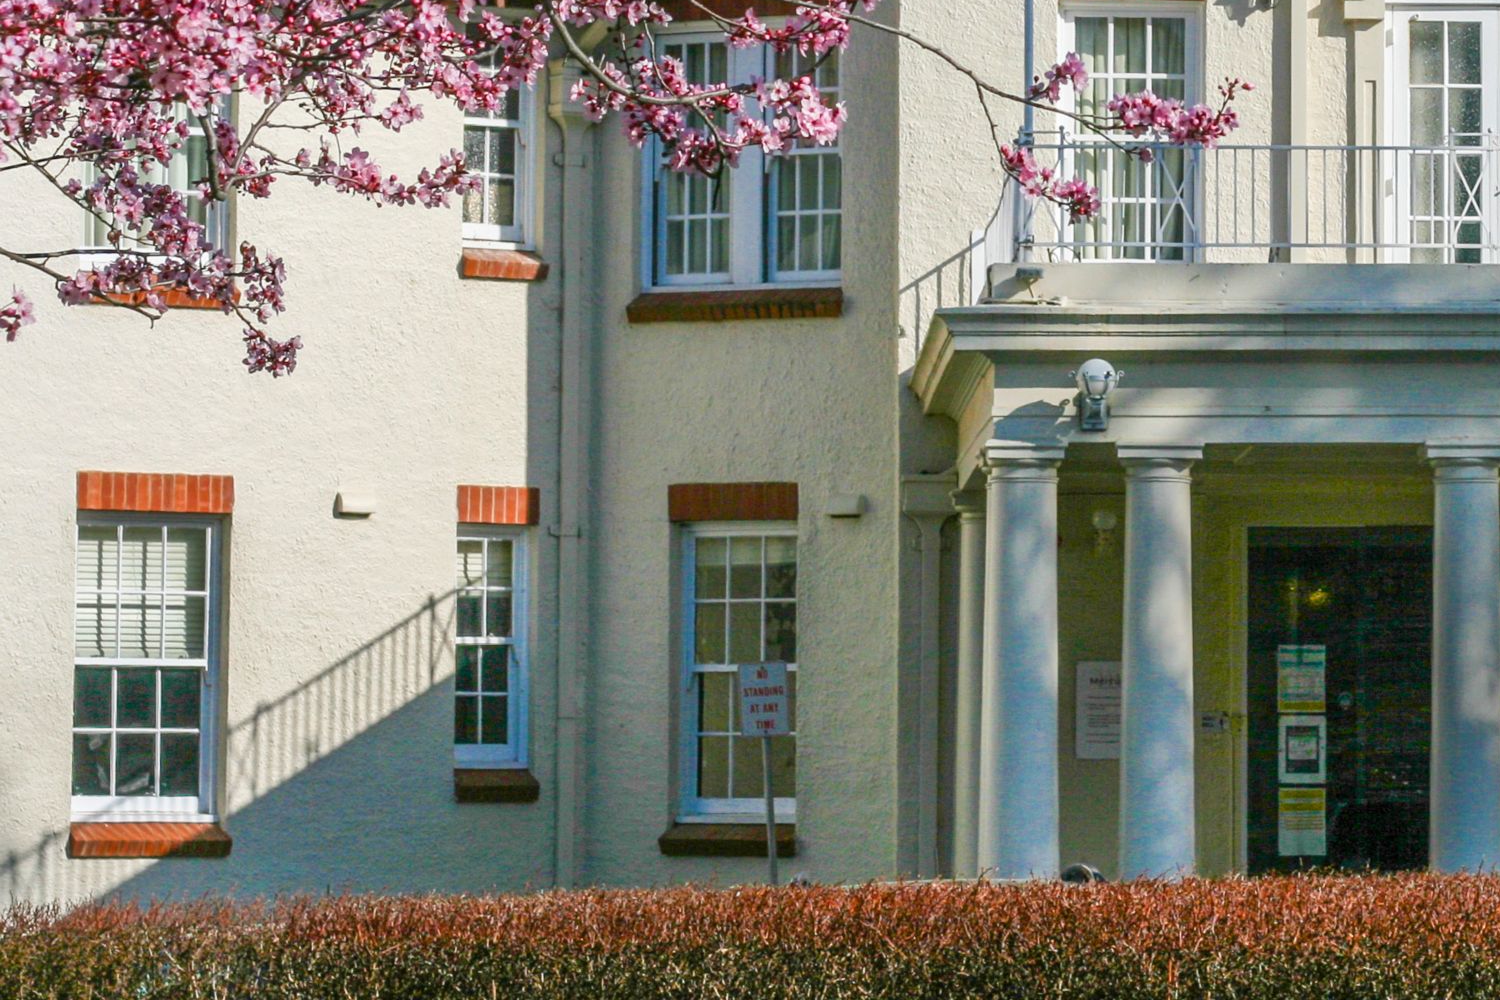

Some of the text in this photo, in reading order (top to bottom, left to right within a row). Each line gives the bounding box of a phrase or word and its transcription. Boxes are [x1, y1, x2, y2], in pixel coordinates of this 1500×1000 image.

[756, 669, 768, 679] NO
[743, 686, 784, 697] STANDING
[750, 703, 778, 713] AT ANY
[755, 720, 775, 729] TIME
